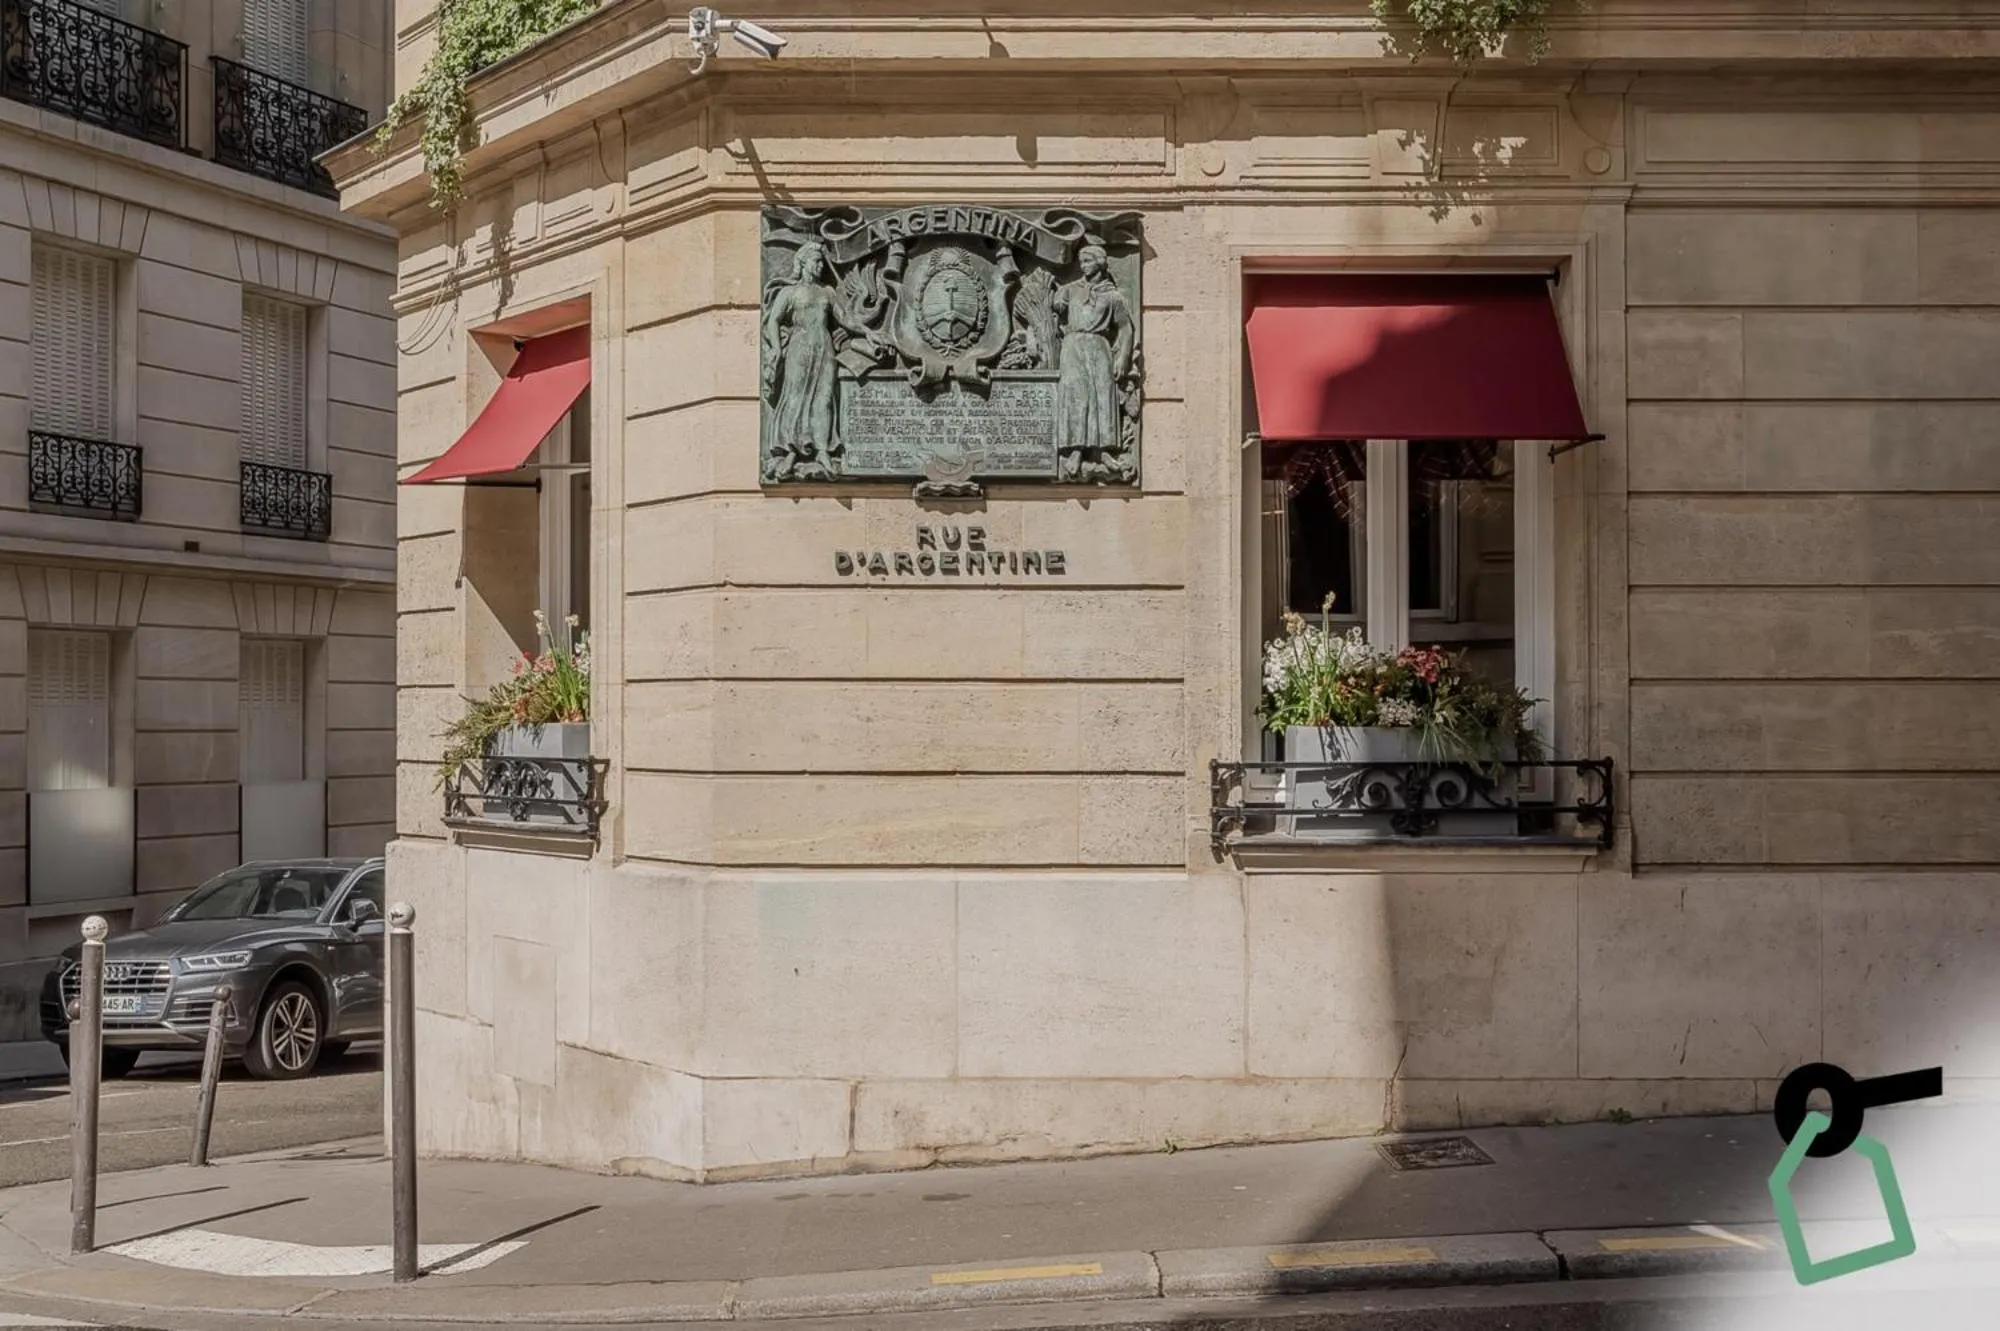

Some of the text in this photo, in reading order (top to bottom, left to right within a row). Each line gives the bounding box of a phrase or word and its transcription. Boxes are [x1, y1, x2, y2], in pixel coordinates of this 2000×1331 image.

[867, 207, 1038, 252] ARGENTINA
[1016, 400, 1052, 408] PARIS
[916, 525, 987, 551] RUE
[835, 551, 1067, 576] D'ARGENTINE
